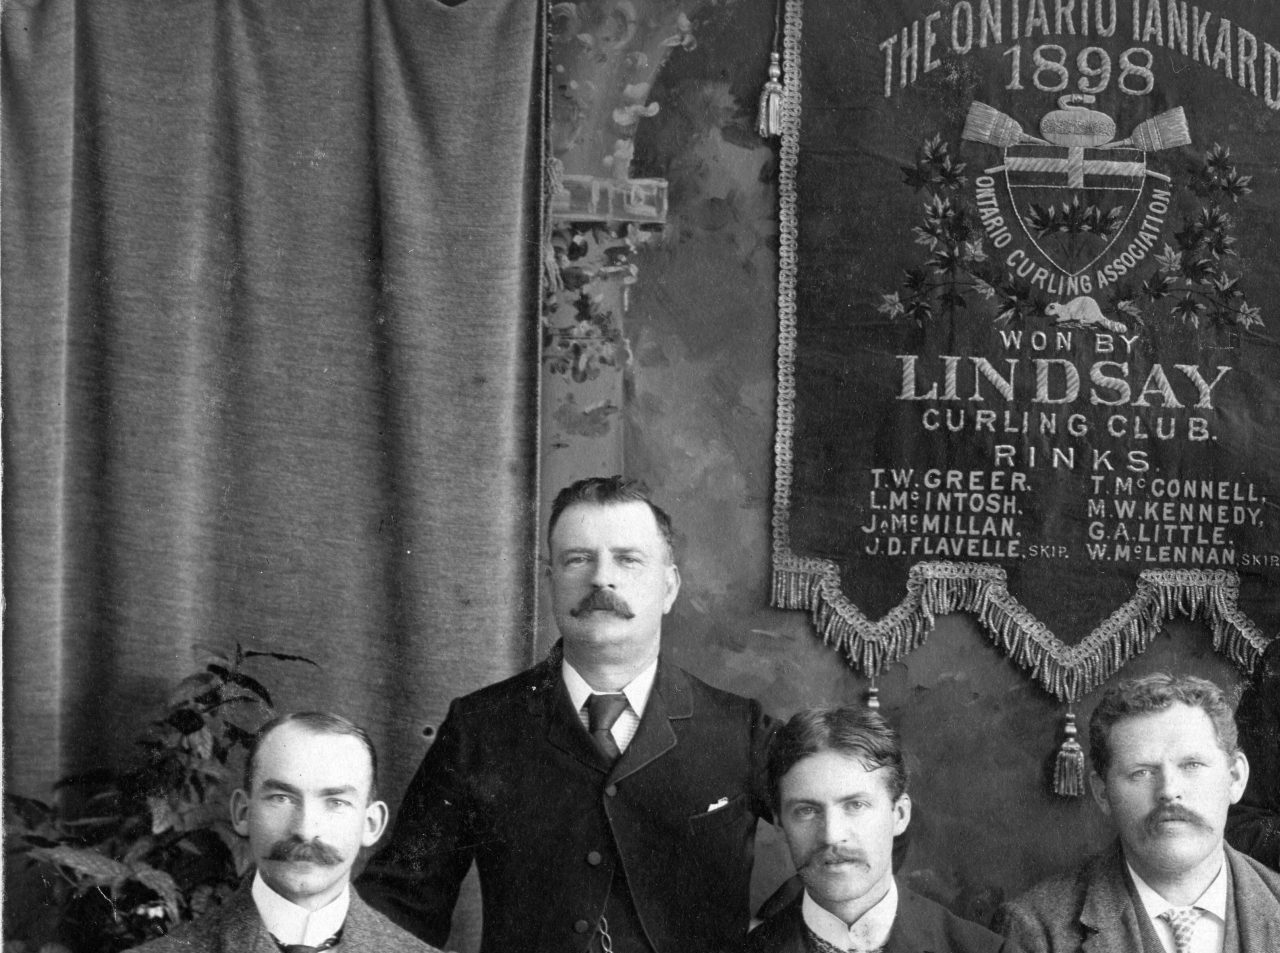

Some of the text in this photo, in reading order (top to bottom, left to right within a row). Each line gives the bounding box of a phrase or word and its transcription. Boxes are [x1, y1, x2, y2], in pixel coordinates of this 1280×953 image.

[879, 11, 942, 98] THE
[952, 0, 1117, 55] ONTARIO
[1003, 44, 1154, 95] 1898
[975, 175, 1012, 249] ONTARIO
[1006, 249, 1093, 296] CURLING
[1000, 330, 1139, 354] WON BY
[895, 354, 1233, 410] LINDSAY
[922, 408, 1218, 442] CURLING CLUB.
